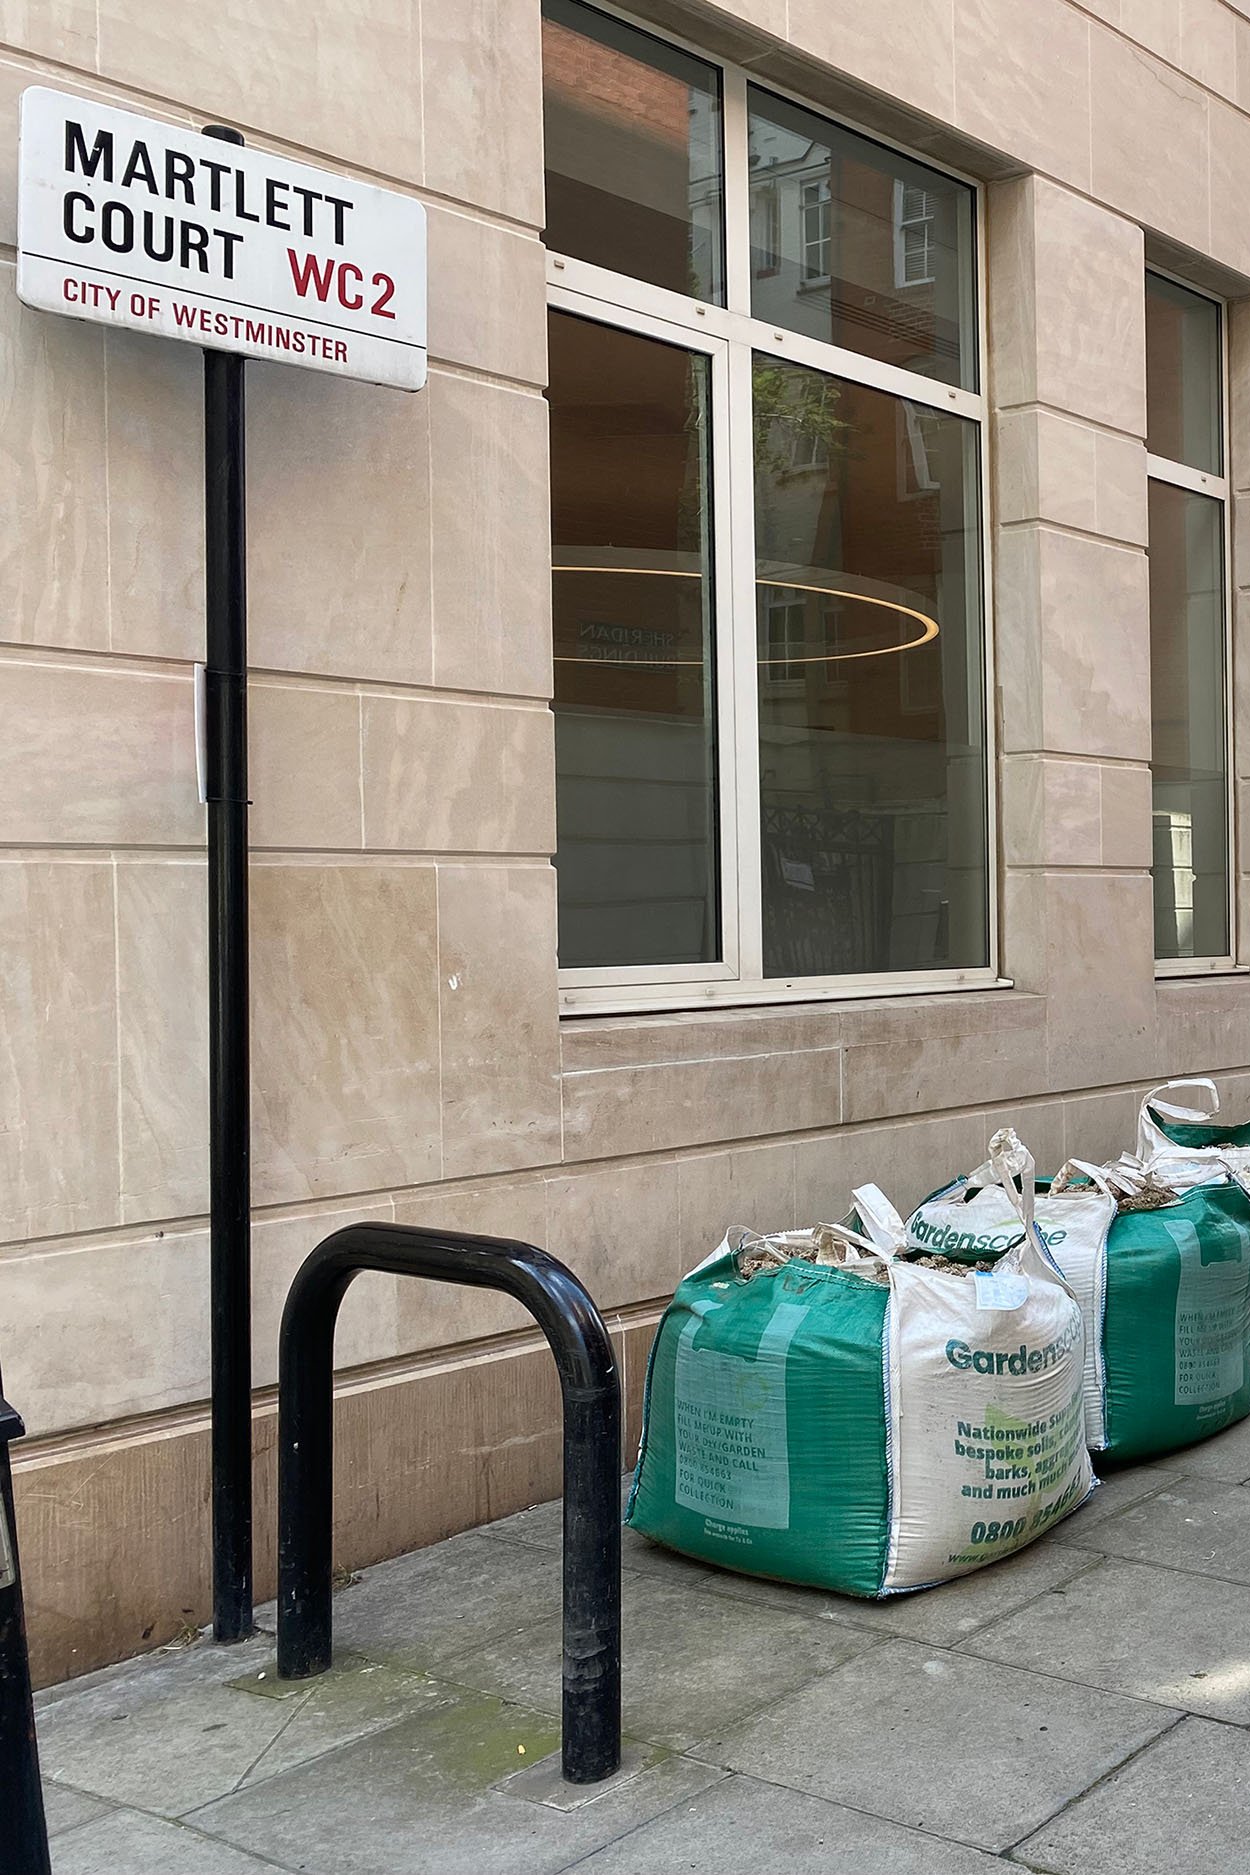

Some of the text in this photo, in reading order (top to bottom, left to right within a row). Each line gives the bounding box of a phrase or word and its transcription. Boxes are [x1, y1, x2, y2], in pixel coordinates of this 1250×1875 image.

[64, 119, 354, 246] MARTLETT
[63, 191, 397, 320] COURT WC2
[63, 277, 348, 364] CITY OF WESTMINSTER
[911, 1211, 1068, 1250] Gardenscae
[677, 1399, 700, 1418] WHEN
[719, 1413, 754, 1429] EMPTY
[677, 1413, 692, 1427] FILL
[724, 1428, 753, 1444] WITH
[957, 1421, 1047, 1442] Nationwide
[708, 1452, 729, 1466] AND
[732, 1458, 759, 1472] CALL
[954, 1440, 1024, 1461] bespoke
[679, 1469, 727, 1494] FOR QUICK
[985, 1461, 1032, 1480] barks,
[679, 1483, 734, 1510] COLLECTION
[961, 1484, 993, 1499] and
[996, 1481, 1036, 1499] much
[970, 1517, 1027, 1545] 0800
